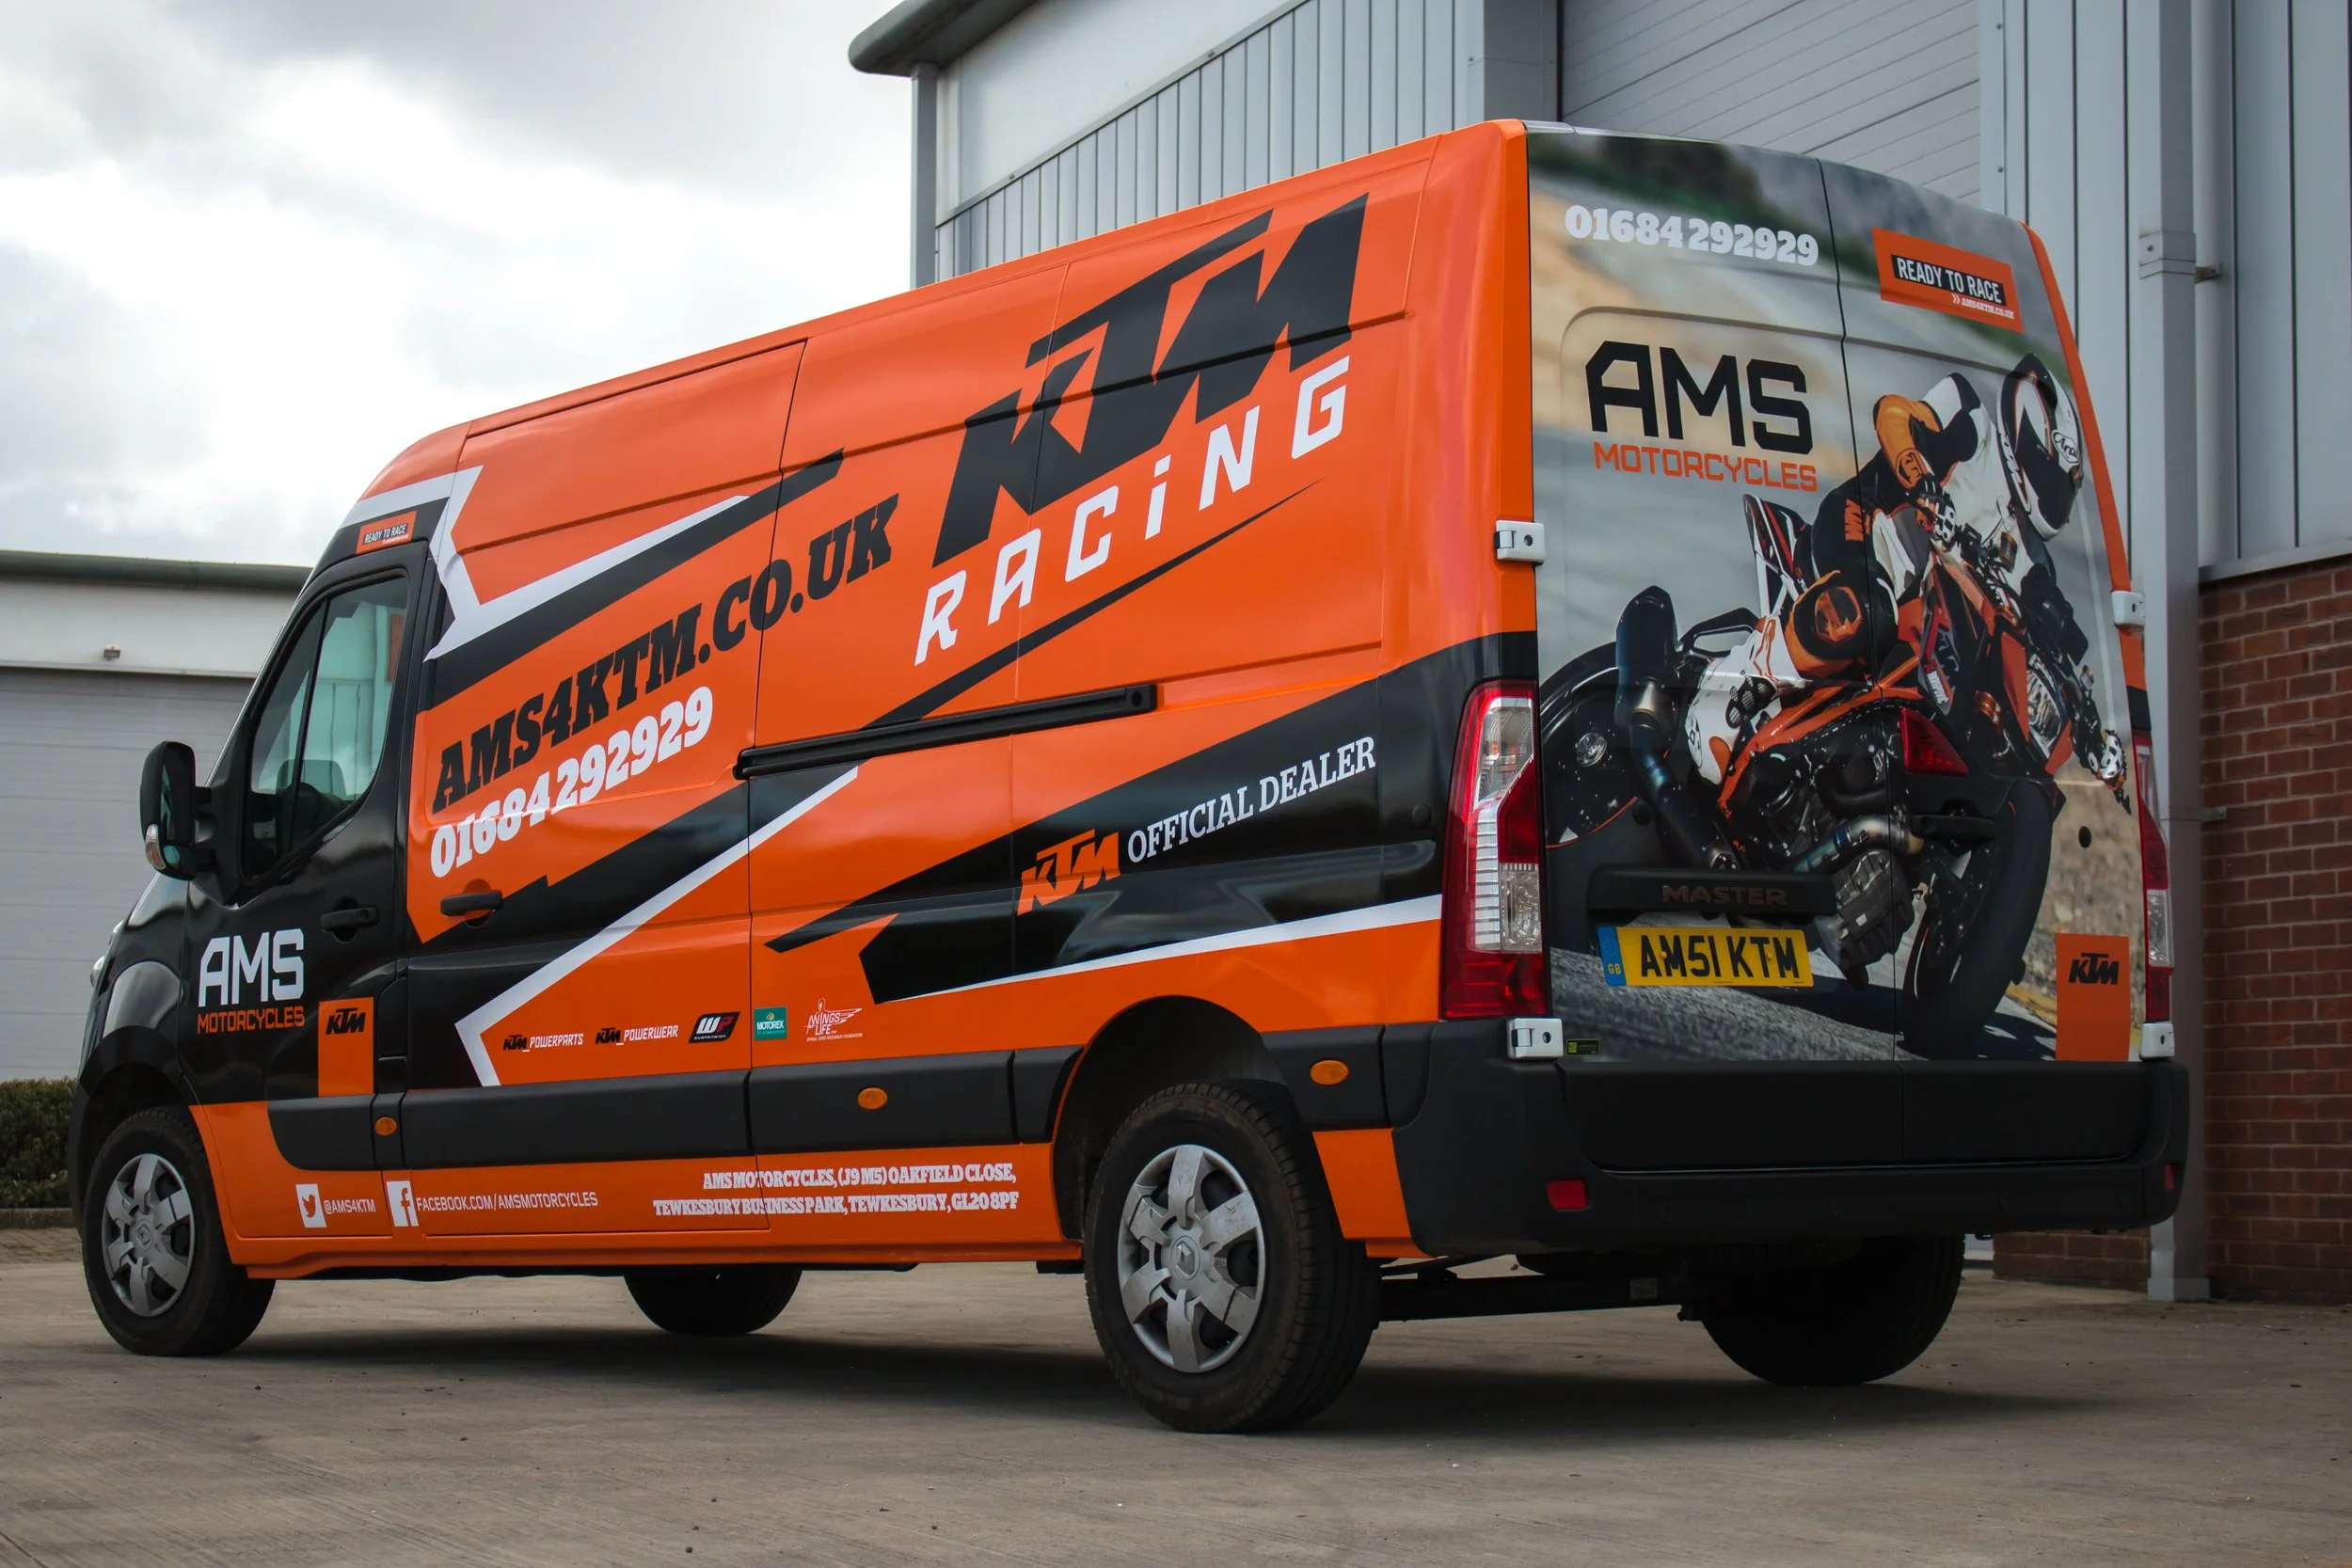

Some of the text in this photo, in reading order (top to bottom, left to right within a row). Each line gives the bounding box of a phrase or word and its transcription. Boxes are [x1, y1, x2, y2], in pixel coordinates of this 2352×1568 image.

[1565, 205, 1819, 266] 01684 292929
[1897, 257, 2002, 304] READY TO RACE
[932, 192, 1369, 569] KTM
[1585, 341, 1813, 454] AMS
[1594, 442, 1818, 492] MOTORCYCLES
[364, 531, 382, 543] READY
[383, 528, 390, 538] TO
[391, 524, 406, 535] RACE
[432, 493, 898, 815] AMS4KTM.CO.UK
[430, 687, 713, 878] 01684 292929
[1128, 736, 1376, 863] OFFICIAL DEALER
[1017, 829, 1120, 916] KTM
[1662, 885, 1786, 906] MASTER
[199, 928, 304, 1007] AMS
[1608, 962, 1622, 974] GB
[1641, 934, 1800, 978] AM51 KTM
[2068, 953, 2120, 985] KTM
[197, 1006, 305, 1034] MOTORCYCLES
[326, 1007, 366, 1035] KTM
[696, 1016, 732, 1035] WP
[756, 1020, 785, 1031] MOTOREX
[703, 1172, 733, 1190] AMS
[888, 1164, 964, 1184] OAKFIELD
[964, 1163, 1017, 1183] CLOSE,
[324, 1199, 376, 1214] @AMS4KTM
[416, 1192, 598, 1212] FACEBOOK.COM/AMSMOTORCYCLES
[653, 1198, 741, 1216] TEWKESBURY
[742, 1196, 807, 1215] BUSINESS
[847, 1193, 952, 1213] TEWKESBURY,
[950, 1192, 991, 1211] GL20
[990, 1191, 1020, 1210] 8PF
